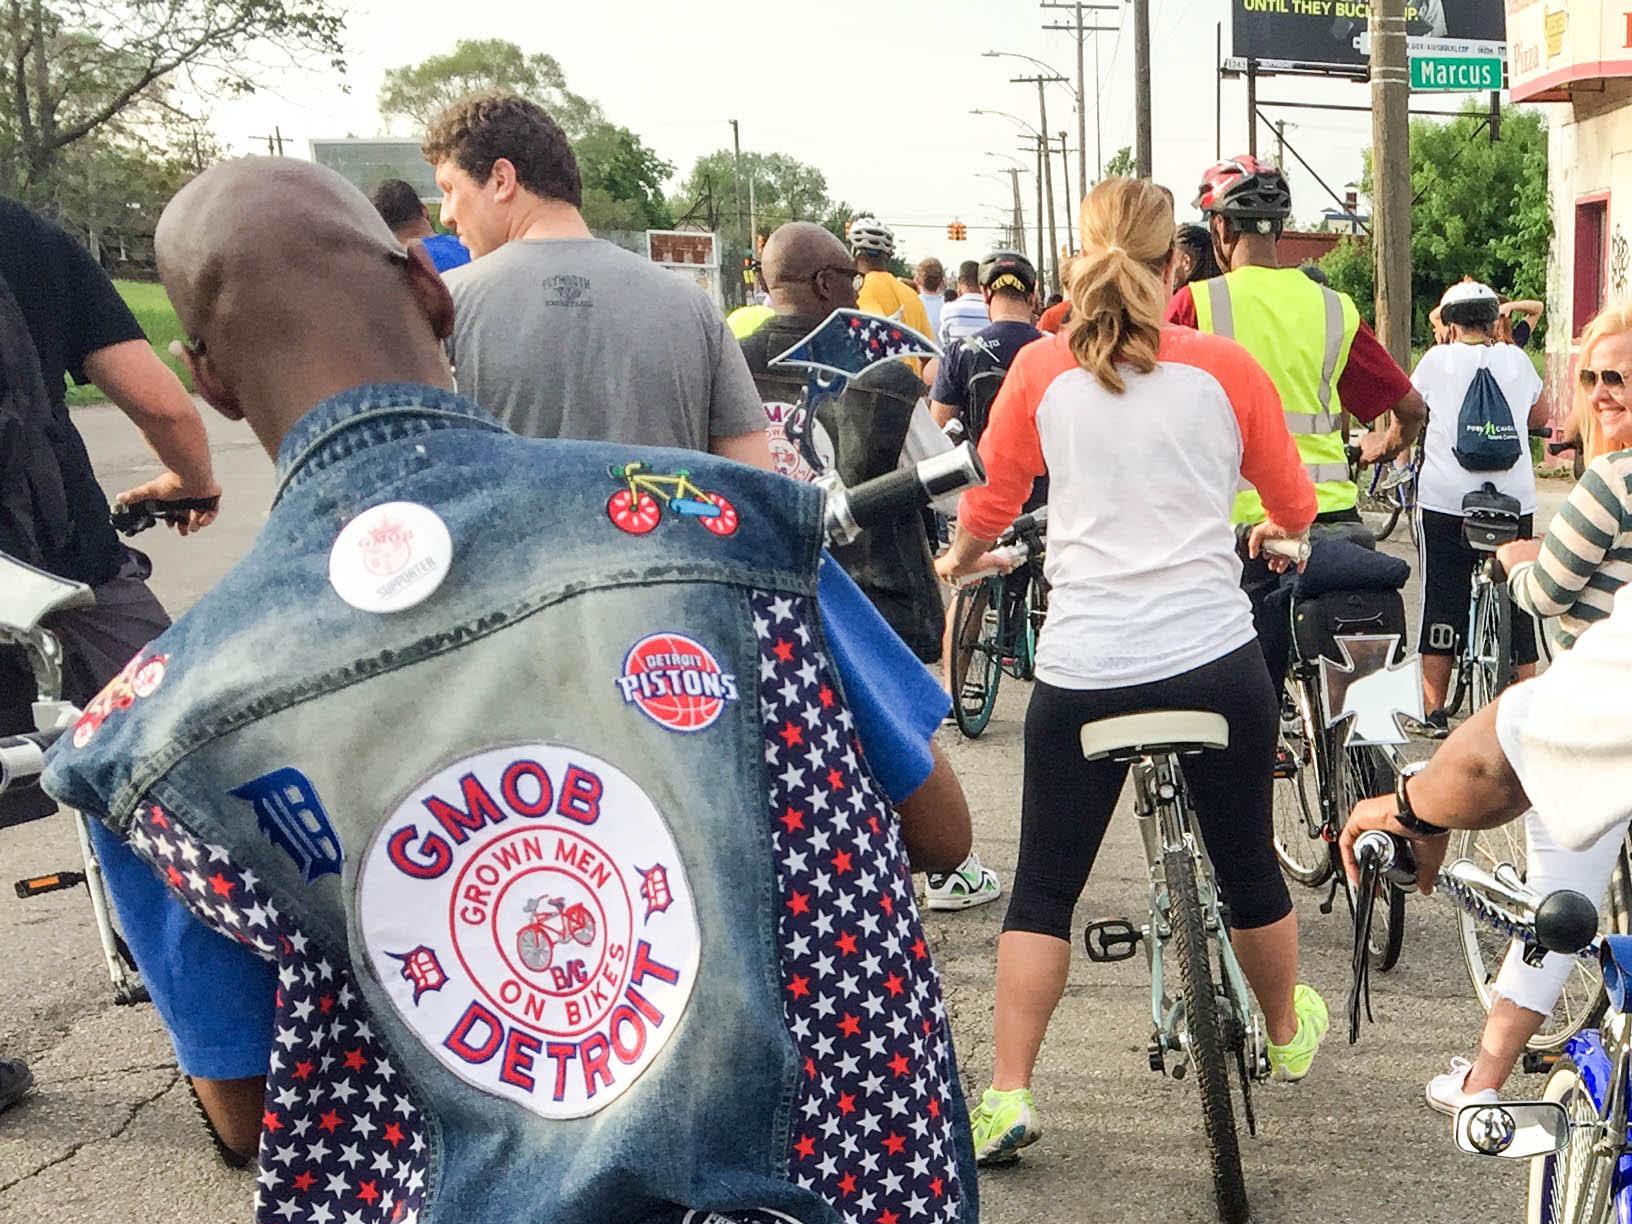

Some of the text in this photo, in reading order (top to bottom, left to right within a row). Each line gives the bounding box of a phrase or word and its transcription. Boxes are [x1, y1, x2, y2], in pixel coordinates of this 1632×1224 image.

[1244, 0, 1289, 13] UNTIL
[1293, 0, 1332, 16] THEY
[1421, 61, 1491, 85] Marcus
[1513, 43, 1539, 76] Pizza
[376, 555, 437, 600] SUPPORTER
[645, 653, 702, 669] DETROIT
[613, 669, 739, 701] PISTONS
[387, 759, 604, 880] GMOB
[460, 836, 611, 925] GROWN MEN
[499, 943, 625, 1026] ON BIKES
[550, 959, 588, 991] B/C
[442, 939, 679, 1102] DETROIT
